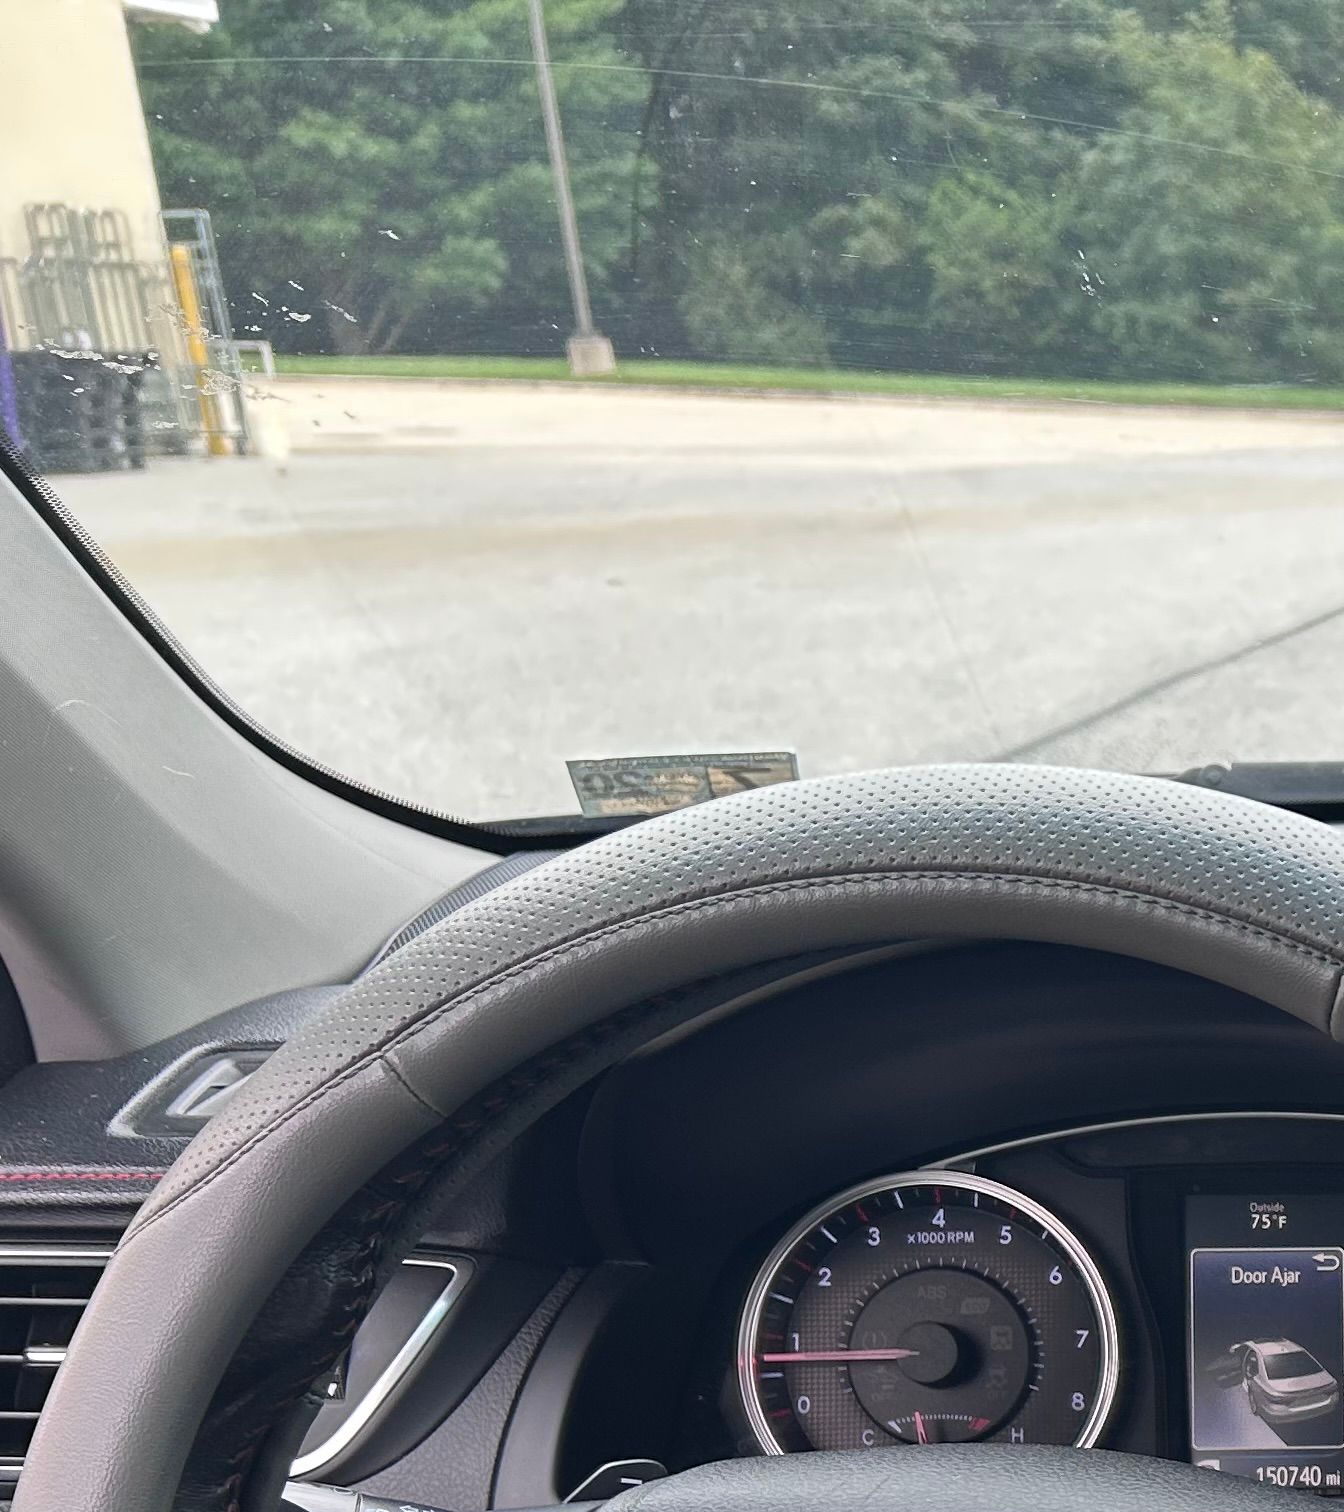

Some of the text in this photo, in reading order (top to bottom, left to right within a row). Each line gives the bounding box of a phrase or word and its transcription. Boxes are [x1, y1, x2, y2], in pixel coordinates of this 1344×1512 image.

[932, 1207, 946, 1228] 4
[1249, 1202, 1285, 1213] Outside
[867, 1226, 881, 1246] 3
[947, 1230, 975, 1244] RPM
[1000, 1225, 1012, 1245] 5
[818, 1267, 832, 1287] 2
[1049, 1265, 1063, 1285] 6
[1231, 1265, 1302, 1287] Door Ajar
[792, 1333, 800, 1352] 1
[1076, 1330, 1090, 1348] 7
[797, 1395, 810, 1415] 0
[1071, 1391, 1085, 1411] 8
[862, 1429, 874, 1446] C
[1011, 1427, 1024, 1443] H
[1325, 1469, 1341, 1486] mi
